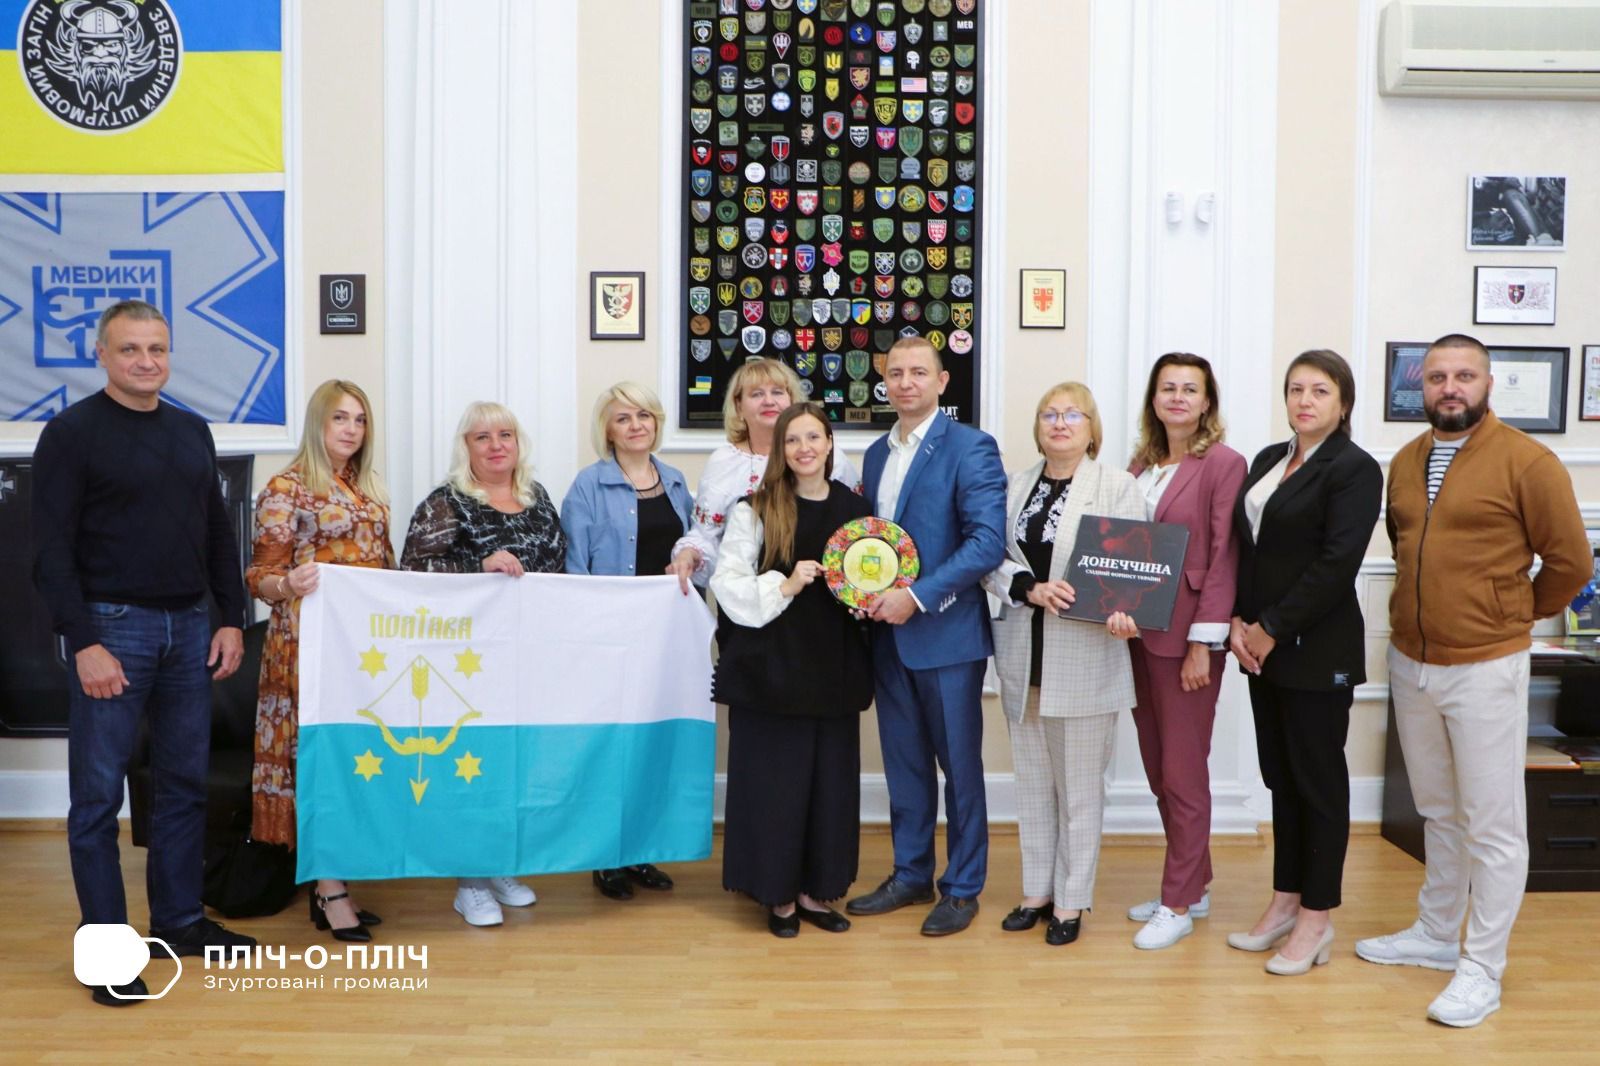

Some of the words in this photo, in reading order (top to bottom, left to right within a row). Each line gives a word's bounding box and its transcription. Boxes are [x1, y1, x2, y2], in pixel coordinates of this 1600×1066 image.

[27, 3, 53, 60] ЗАГІН
[957, 20, 974, 29] MED
[140, 8, 175, 110] ЗВЕДЕНИЙ
[28, 65, 140, 128] ШТУРМОВИЙ
[850, 411, 866, 420] MED
[1078, 555, 1171, 575] ДОНЕЧЧИНА
[369, 605, 472, 640] ПОЛТАВА
